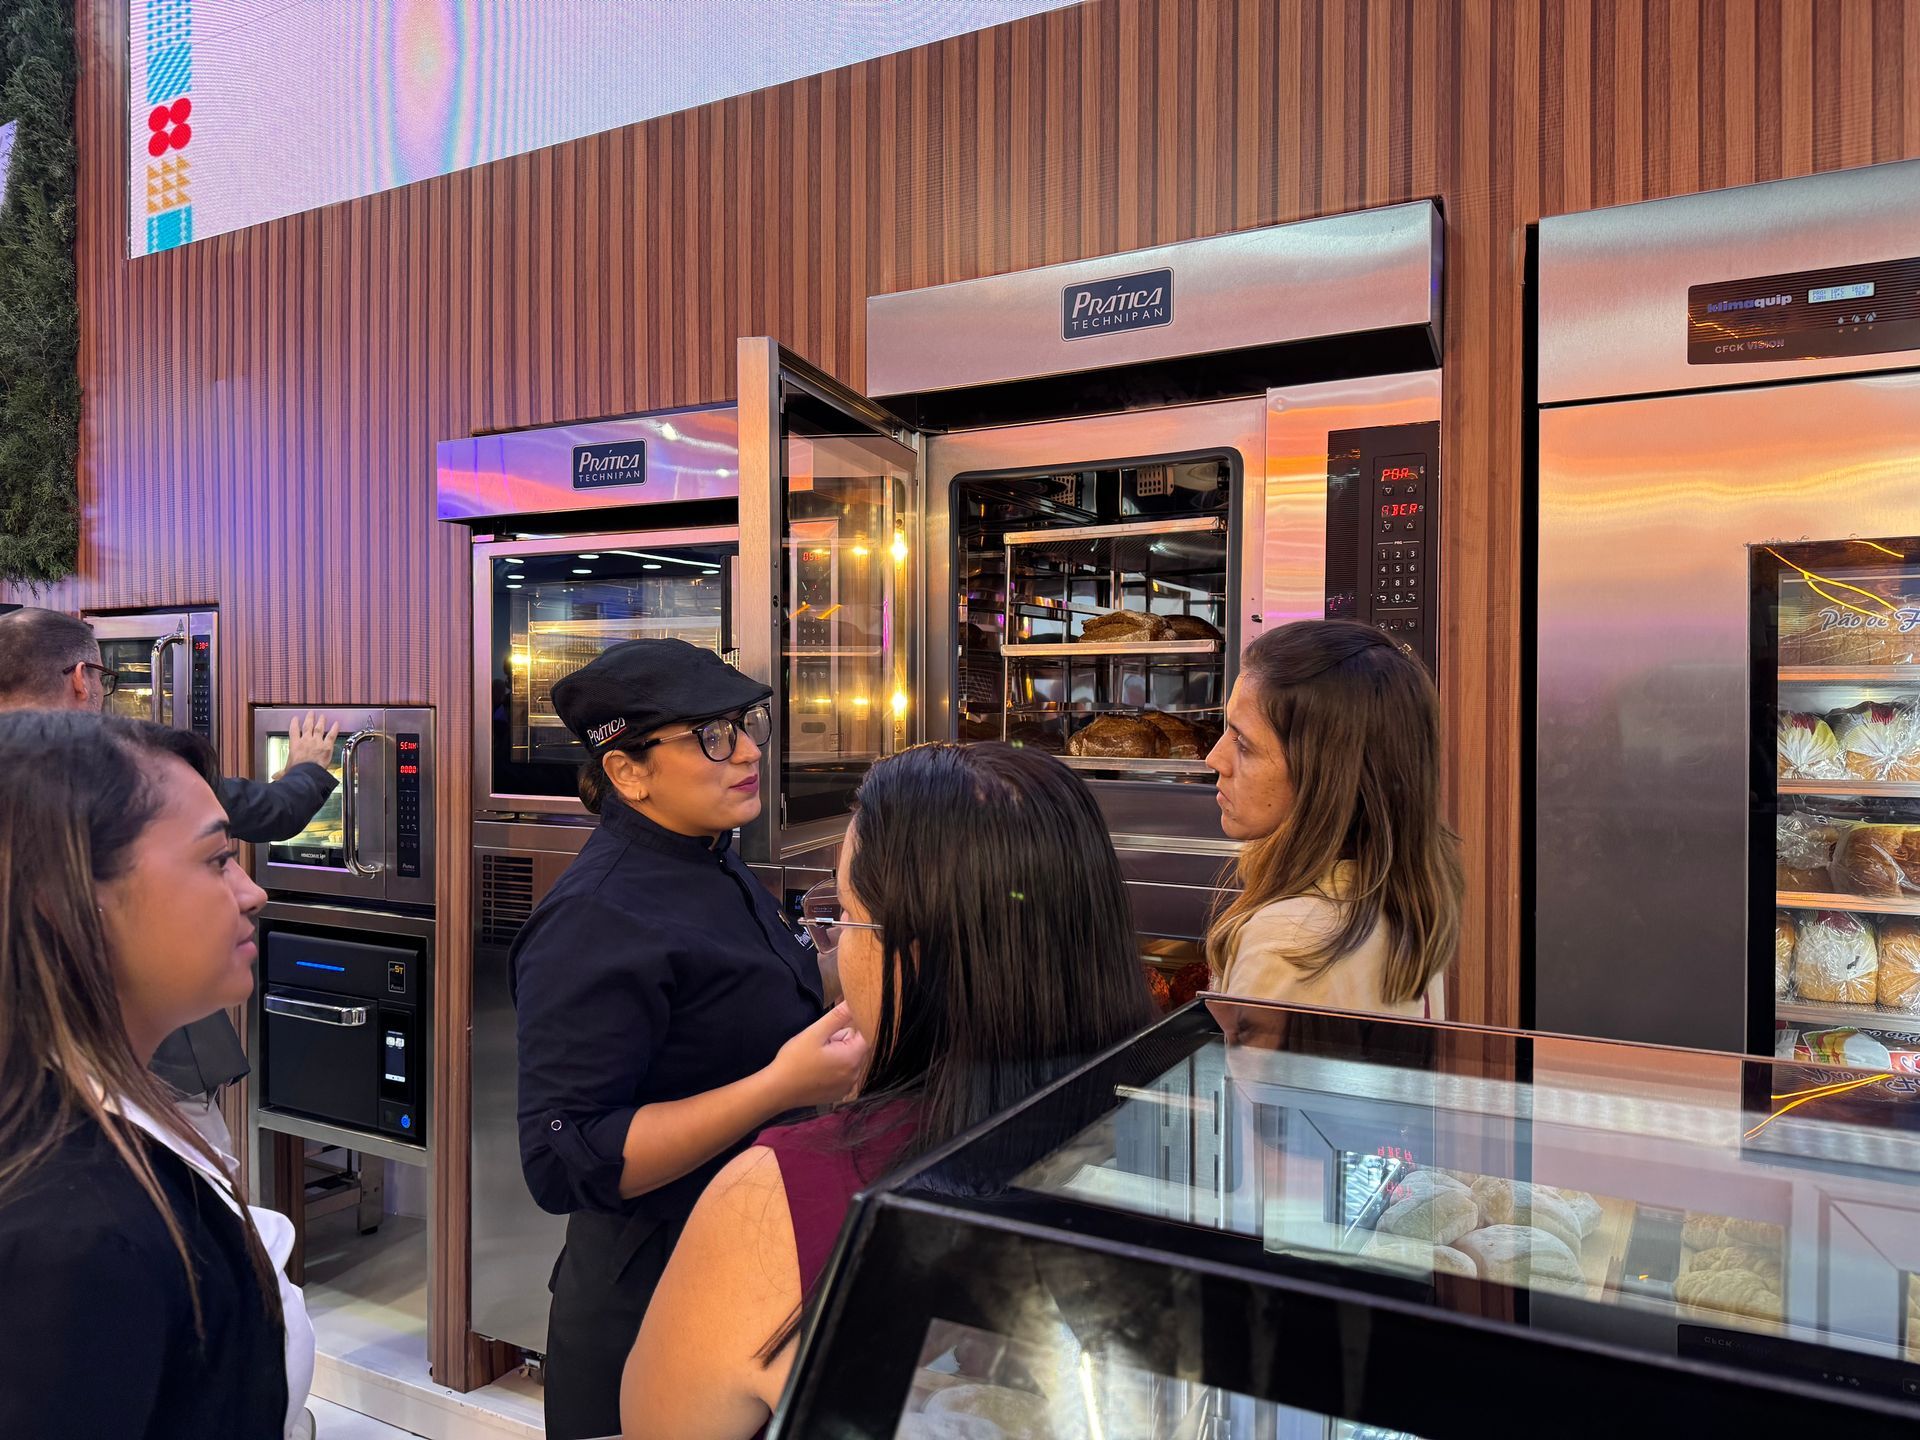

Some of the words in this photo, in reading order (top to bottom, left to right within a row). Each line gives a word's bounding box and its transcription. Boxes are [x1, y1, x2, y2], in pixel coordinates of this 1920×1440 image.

[1707, 294, 1793, 313] klimaquip
[1072, 307, 1163, 330] TECHNIPAN
[1746, 339, 1785, 350] VISION
[579, 470, 640, 482] TECHNIPAN
[1818, 608, 1862, 632] Pão
